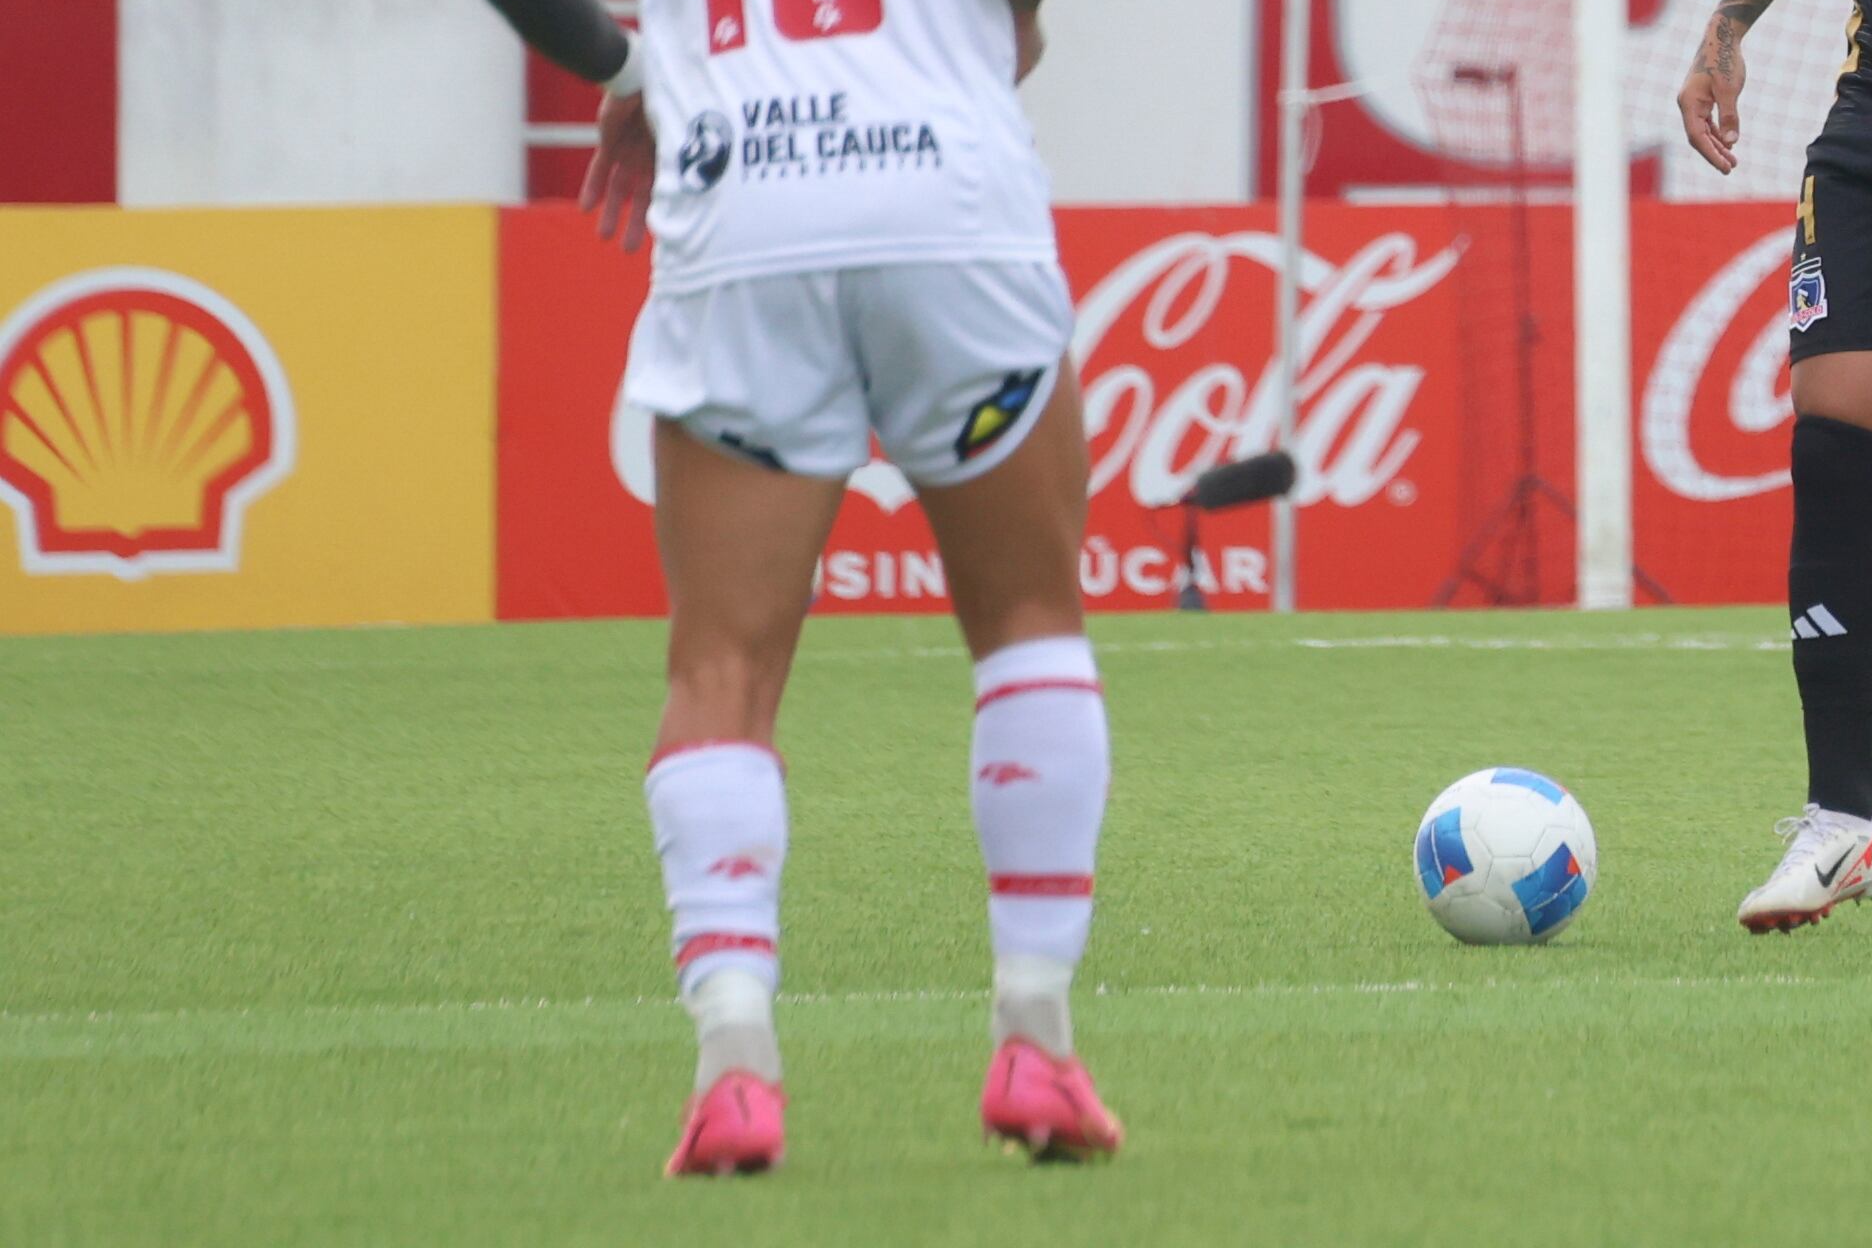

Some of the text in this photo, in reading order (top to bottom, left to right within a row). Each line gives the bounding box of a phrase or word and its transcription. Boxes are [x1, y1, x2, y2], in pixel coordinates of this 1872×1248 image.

[742, 92, 846, 128] VALLE
[743, 121, 940, 165] DEL CAUCA
[828, 536, 1269, 600] SIN ÚCAR
